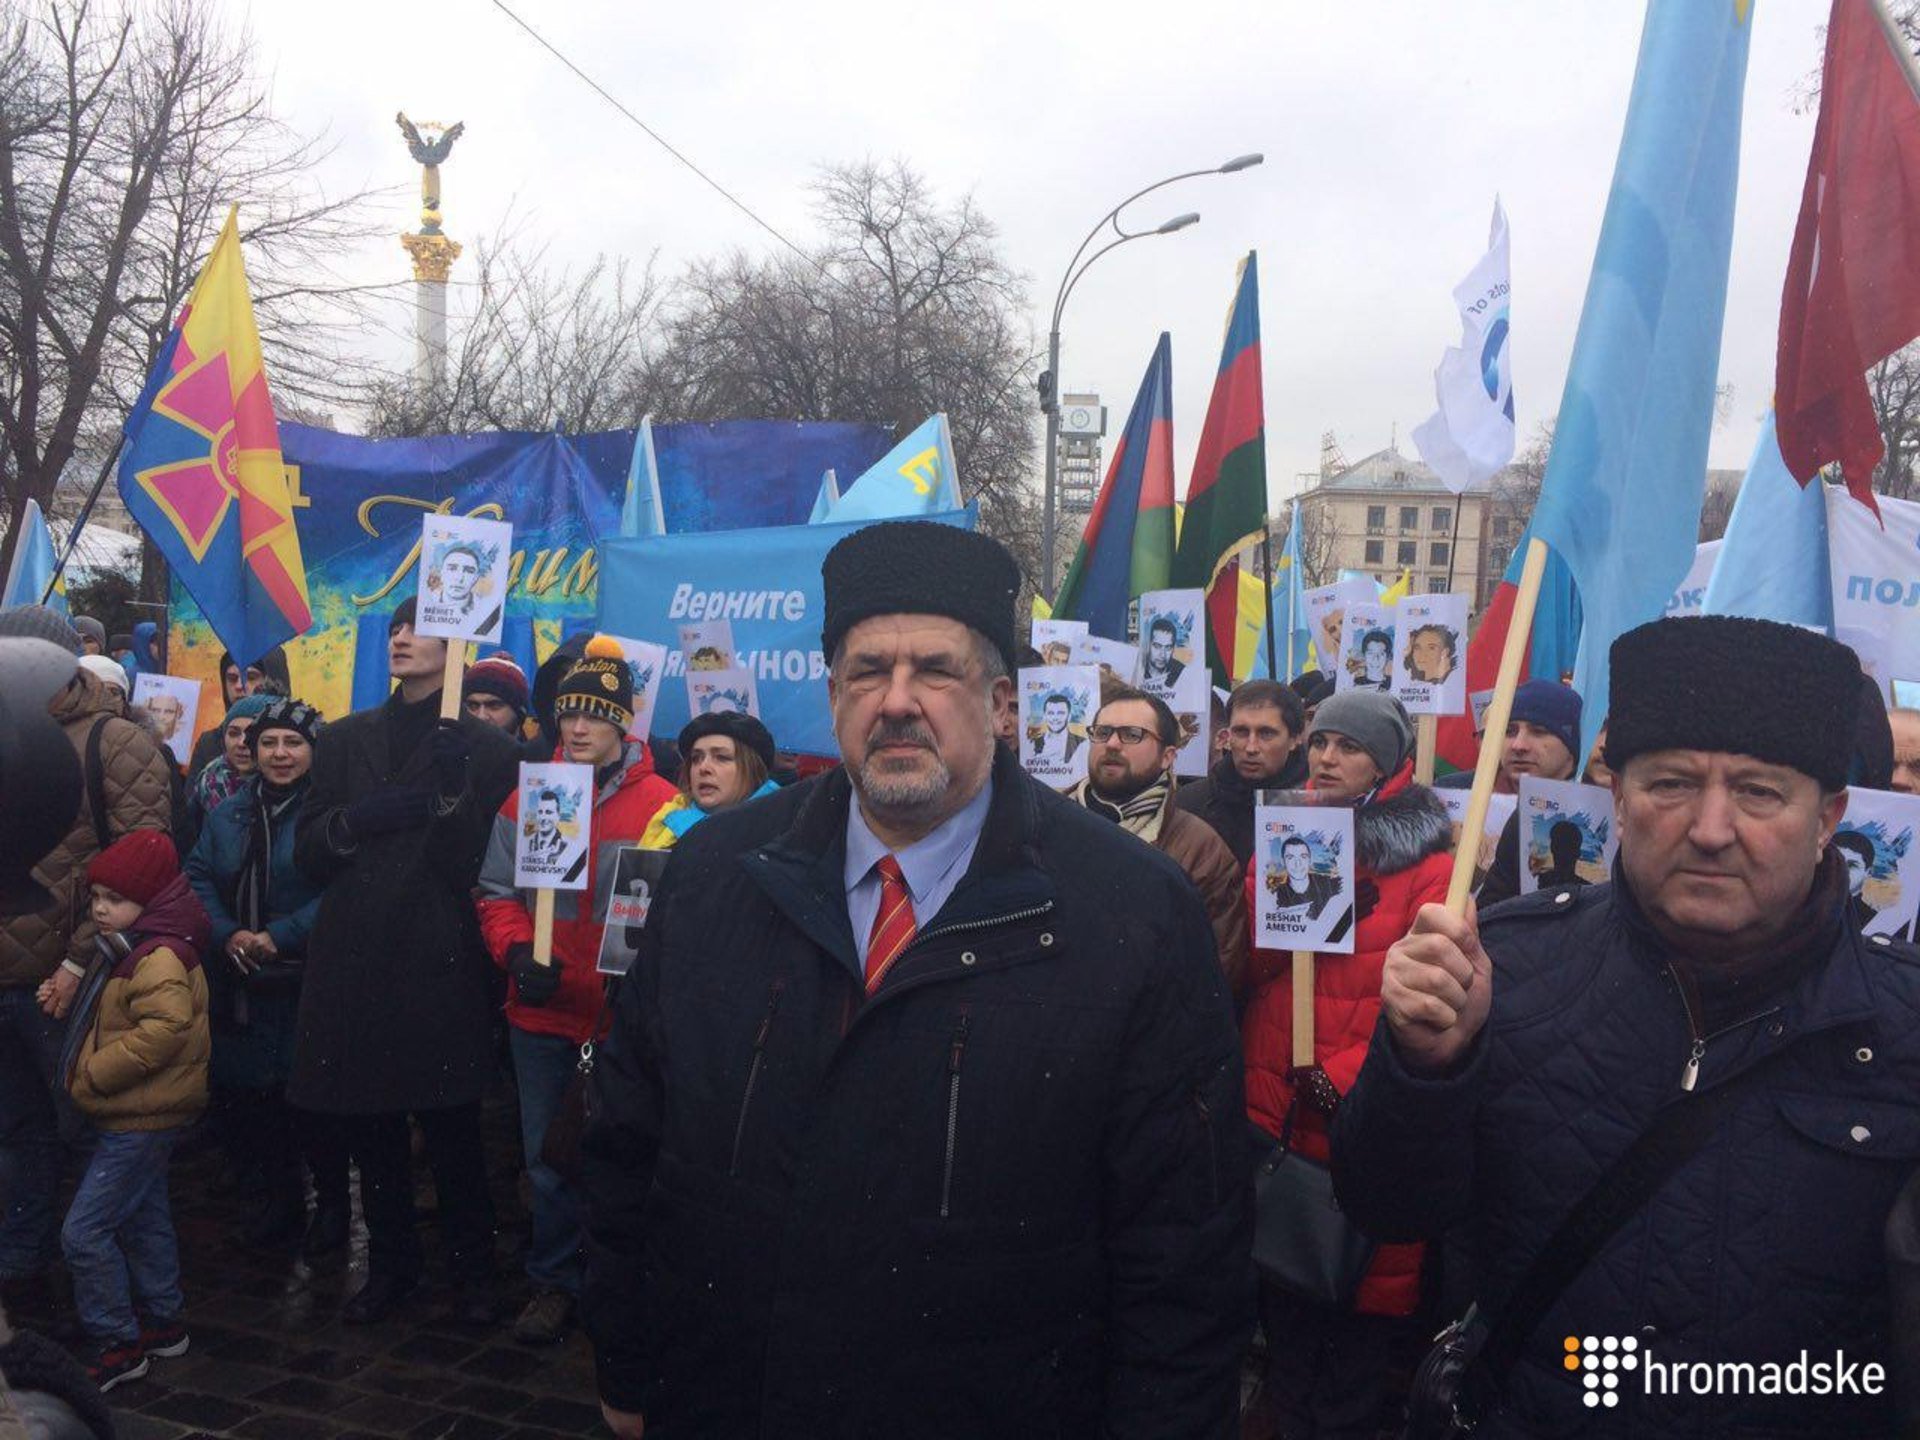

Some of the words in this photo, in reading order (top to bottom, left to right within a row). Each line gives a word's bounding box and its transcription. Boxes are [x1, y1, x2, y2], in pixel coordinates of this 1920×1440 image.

[668, 583, 807, 622] Верните
[1265, 912, 1303, 924] RESHAT
[1265, 922, 1308, 933] AMETOV
